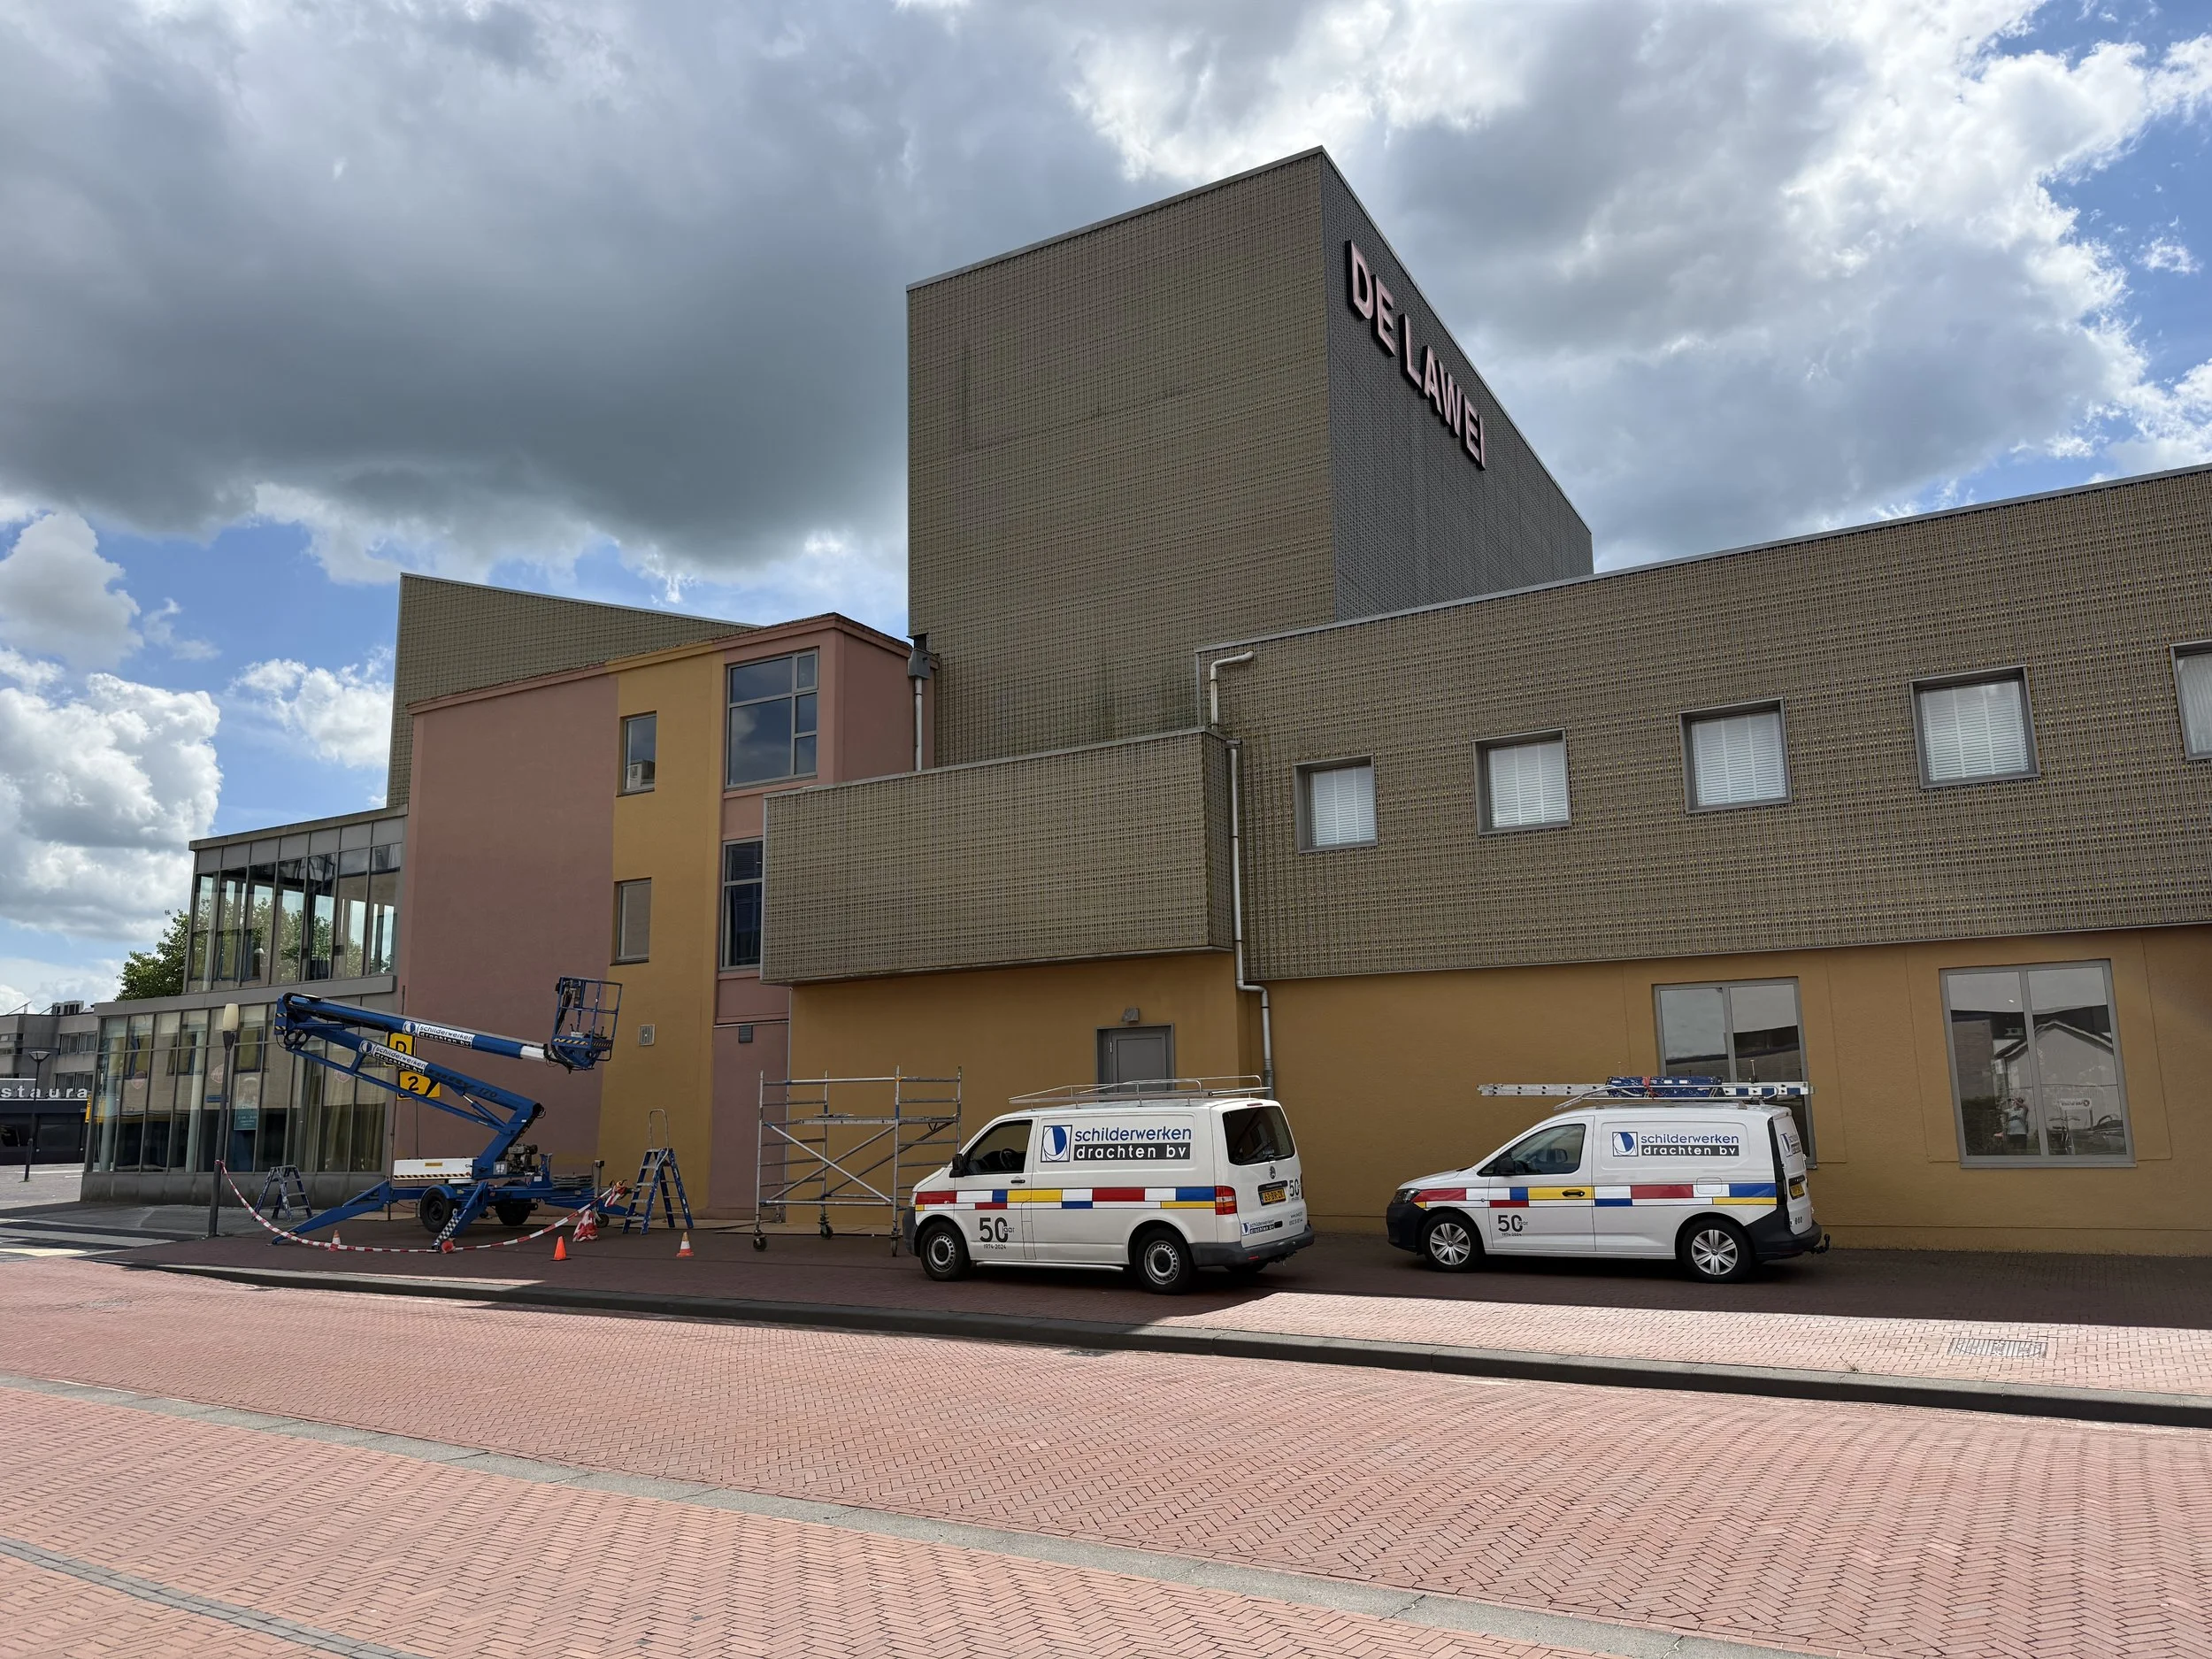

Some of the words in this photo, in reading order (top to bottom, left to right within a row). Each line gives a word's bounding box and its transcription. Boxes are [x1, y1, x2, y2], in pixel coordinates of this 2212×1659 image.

[1345, 240, 1396, 357] DE
[1399, 313, 1486, 471] LAWEI
[419, 1025, 473, 1041] schilderwerken
[420, 1033, 457, 1044] drachten
[375, 1046, 426, 1068] schilderwerken
[375, 1053, 411, 1069] drachten
[408, 1076, 419, 1091] 2
[1074, 1125, 1192, 1141] schilderwerken
[1640, 1133, 1740, 1144] schilderwerken
[1076, 1145, 1156, 1159] drachten
[1166, 1144, 1187, 1158] bv
[1643, 1146, 1711, 1156] drachten
[1719, 1146, 1736, 1156] bv
[1289, 1179, 1300, 1197] 50
[979, 1217, 1009, 1243] 50
[1498, 1215, 1523, 1232] 50
